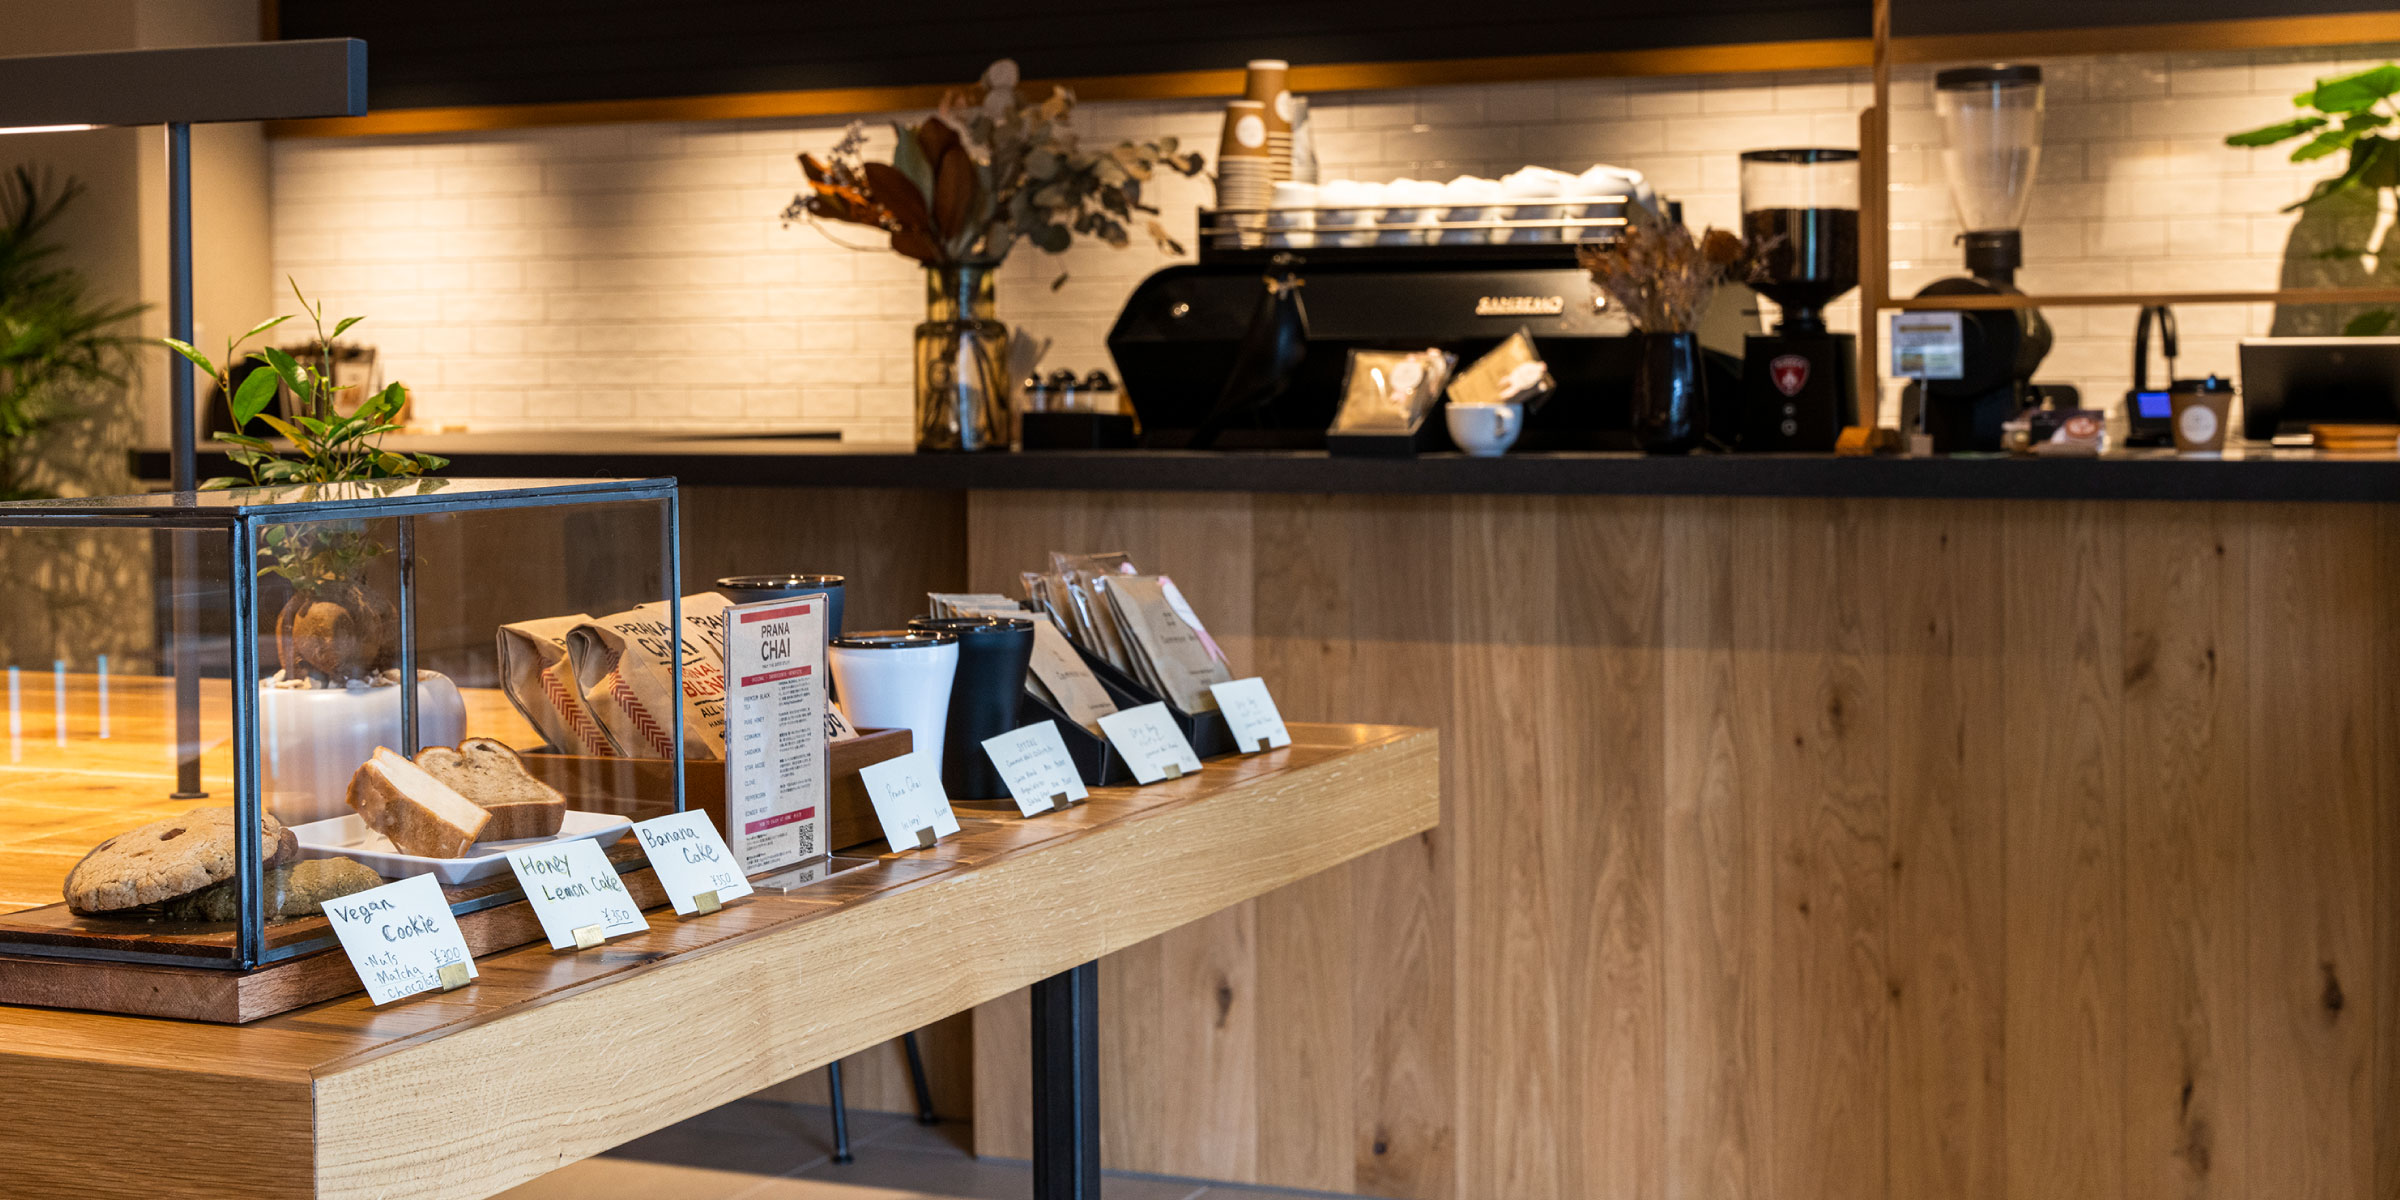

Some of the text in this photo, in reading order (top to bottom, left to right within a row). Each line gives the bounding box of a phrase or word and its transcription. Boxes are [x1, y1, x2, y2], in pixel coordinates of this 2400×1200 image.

[614, 621, 671, 637] PRANA
[761, 622, 790, 638] PRANA
[761, 637, 790, 661] CHAI
[700, 705, 720, 718] ALL
[642, 828, 700, 848] Banana
[682, 843, 720, 864] Cake
[519, 854, 572, 878] Honey
[541, 870, 622, 901] Lemon Cake
[710, 872, 732, 886] ¥350
[334, 899, 396, 924] Vegan
[601, 907, 630, 923] ¥350
[382, 914, 440, 942] Cookie
[430, 947, 461, 964] ¥300
[376, 964, 423, 984] Matcha
